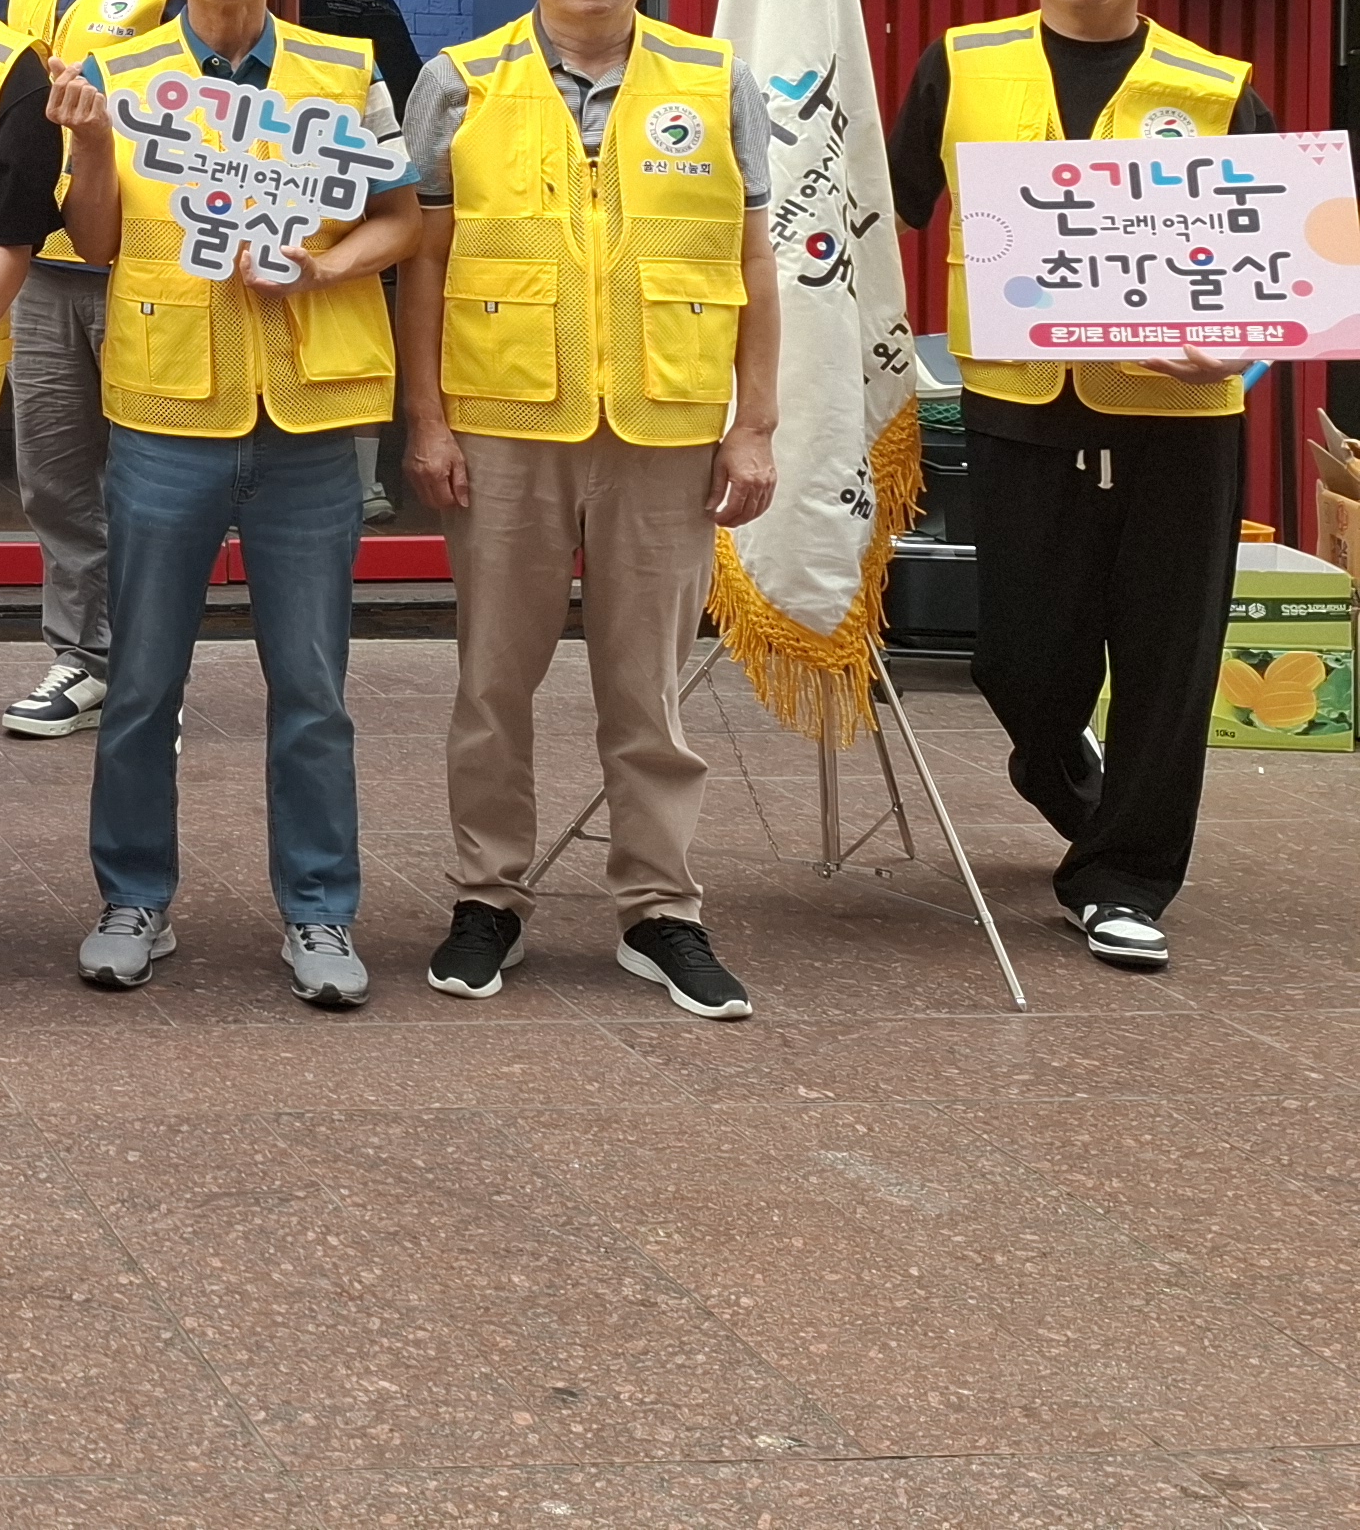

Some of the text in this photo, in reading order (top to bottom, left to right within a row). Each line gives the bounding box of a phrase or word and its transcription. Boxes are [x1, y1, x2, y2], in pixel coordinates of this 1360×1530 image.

[118, 80, 394, 209] 온기나눔
[188, 153, 319, 205] 그래! 역시!
[1020, 157, 1287, 238] 온기나눔
[180, 190, 309, 274] 울산
[1101, 213, 1225, 242] 그래! 역시!
[1051, 325, 1285, 344] 온기로 하나되는 따뜻한 울산
